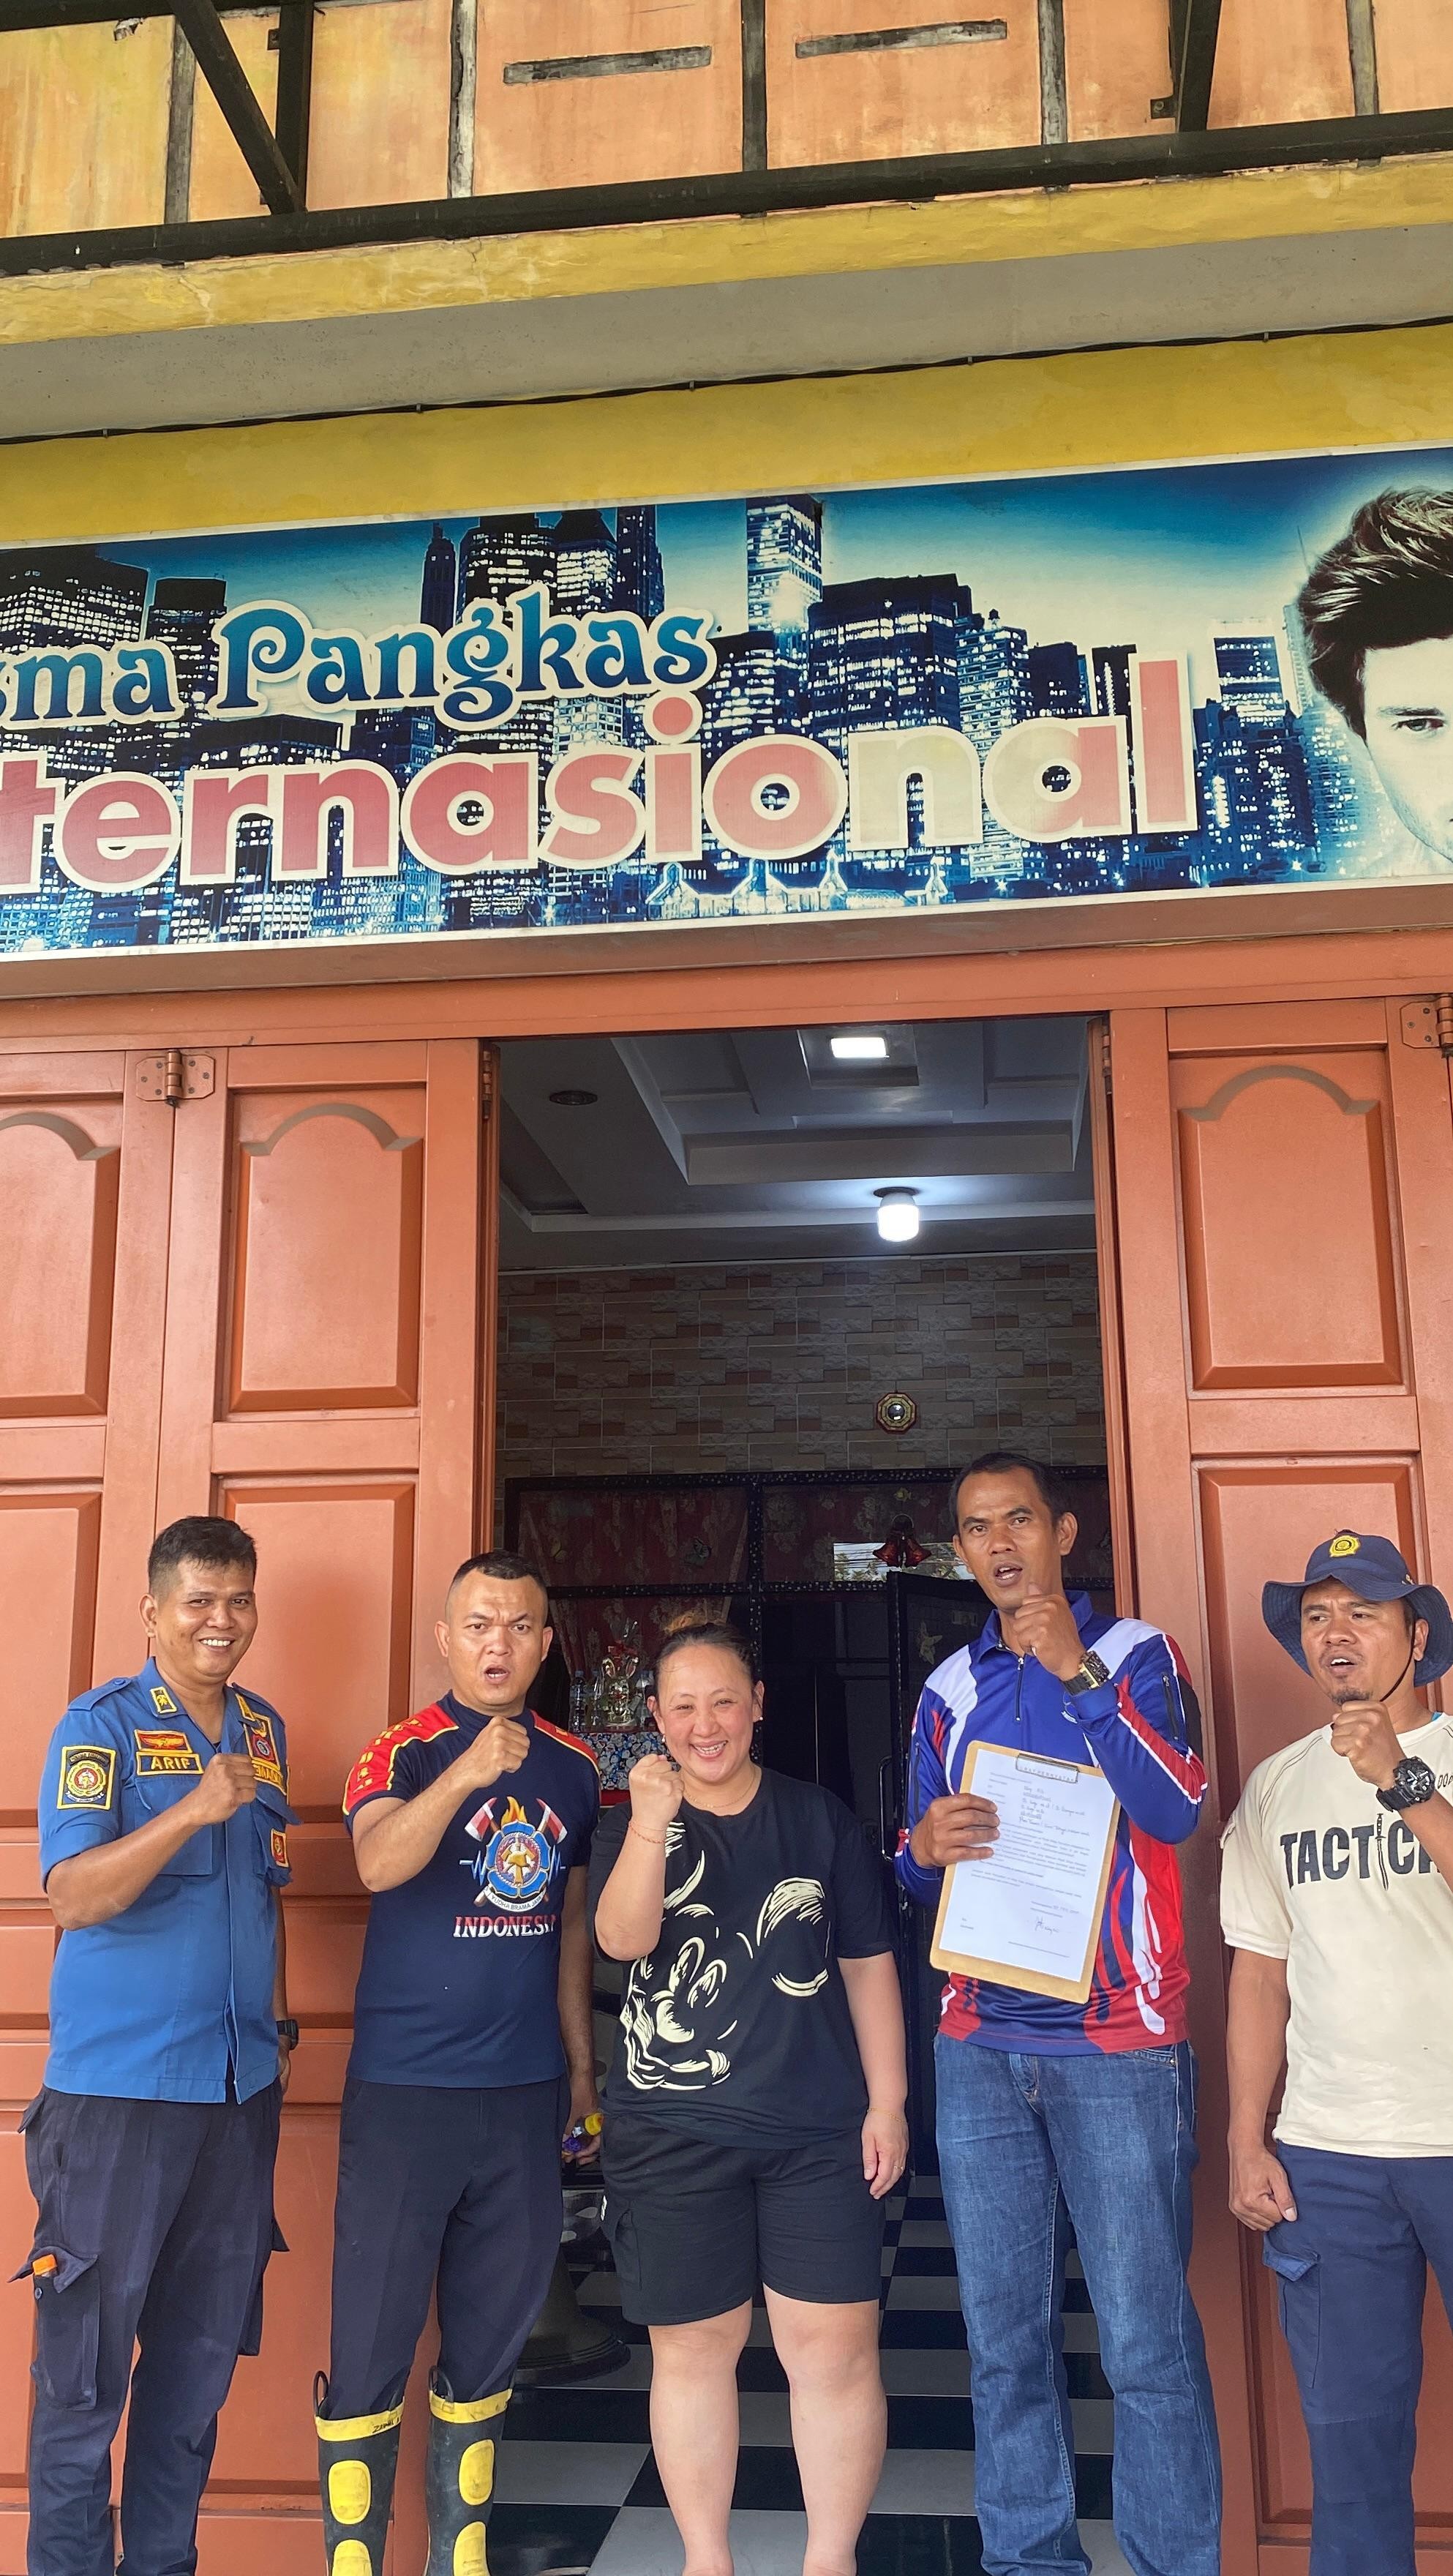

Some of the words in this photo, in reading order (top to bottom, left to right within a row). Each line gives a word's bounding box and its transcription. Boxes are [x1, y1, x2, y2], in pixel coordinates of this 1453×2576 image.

[0, 648, 176, 721] ma
[215, 590, 710, 724] Pangkas
[150, 1756, 191, 1770] ARIF
